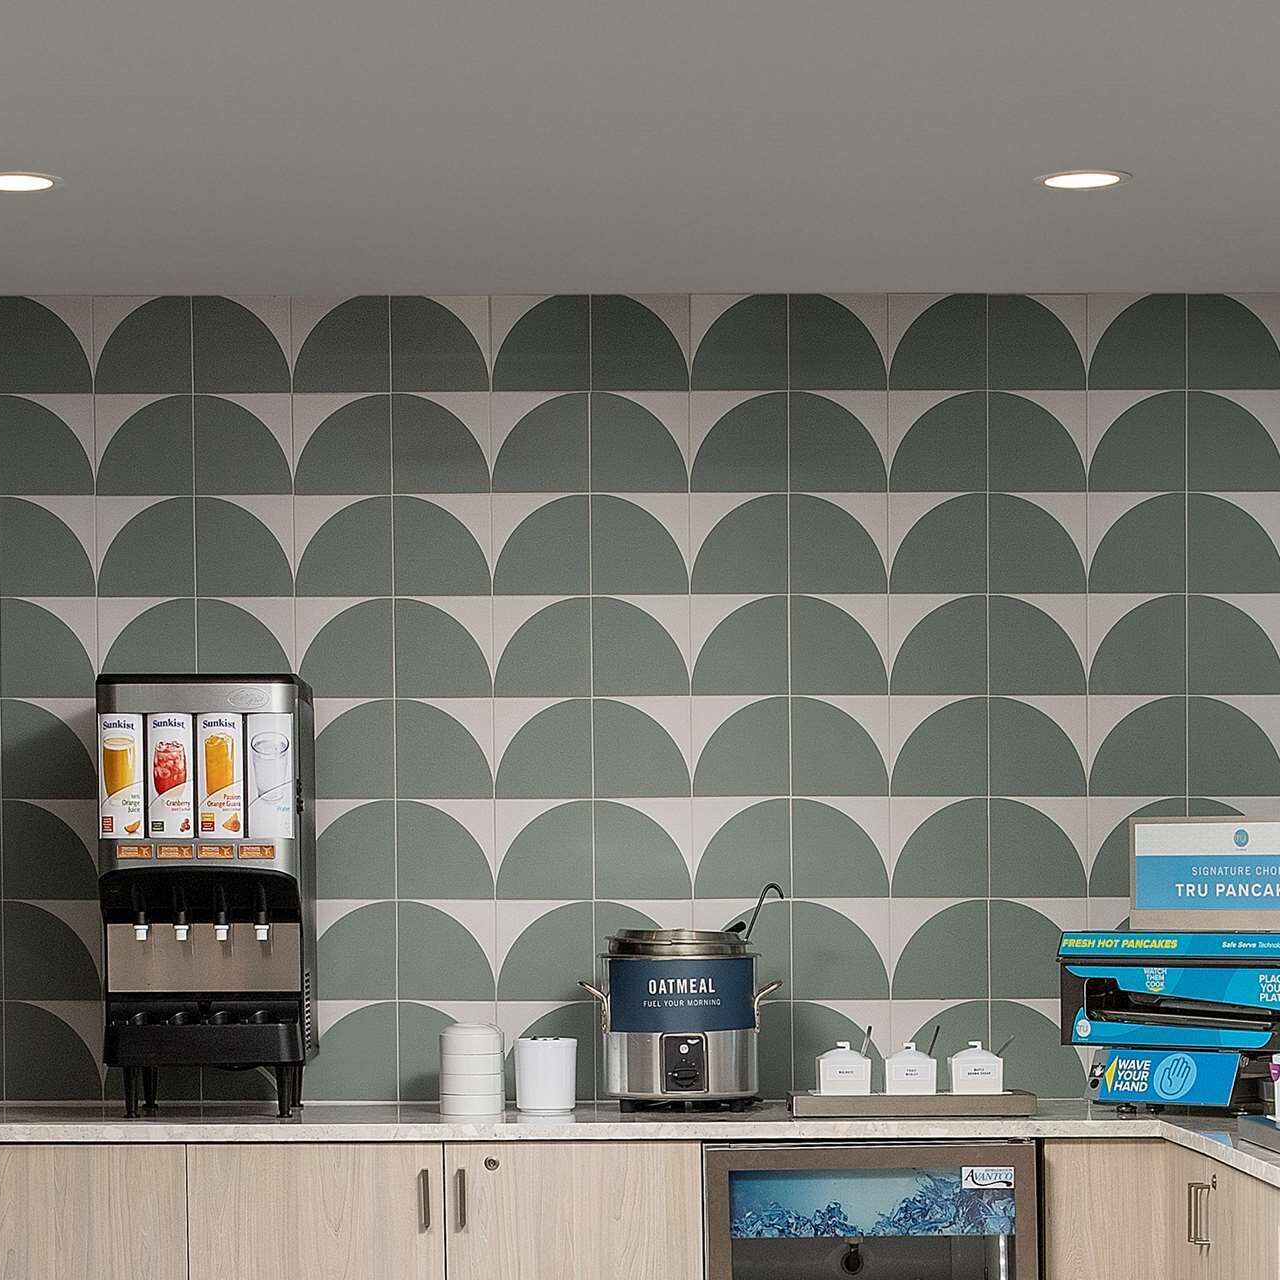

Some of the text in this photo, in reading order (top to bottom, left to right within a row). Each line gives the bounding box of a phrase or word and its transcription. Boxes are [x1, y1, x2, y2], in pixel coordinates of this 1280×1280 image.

[102, 719, 135, 730] Sunkist
[152, 718, 185, 729] Sunkist
[202, 718, 236, 729] Sunkist
[165, 799, 191, 807] Cranberry
[206, 800, 225, 808] Orange
[1191, 866, 1251, 876] SIGNATURE
[1175, 883, 1209, 897] TRU
[1062, 938, 1178, 949] FRESH HOT PANCAKES
[1221, 941, 1237, 949] Safe
[648, 977, 716, 995] OATMEAL
[663, 999, 685, 1007] YOUR
[1118, 1059, 1152, 1070] WAVE
[1117, 1070, 1150, 1082] YOUR
[1114, 1081, 1149, 1092] HAND
[965, 1169, 1013, 1187] AVANTCO
